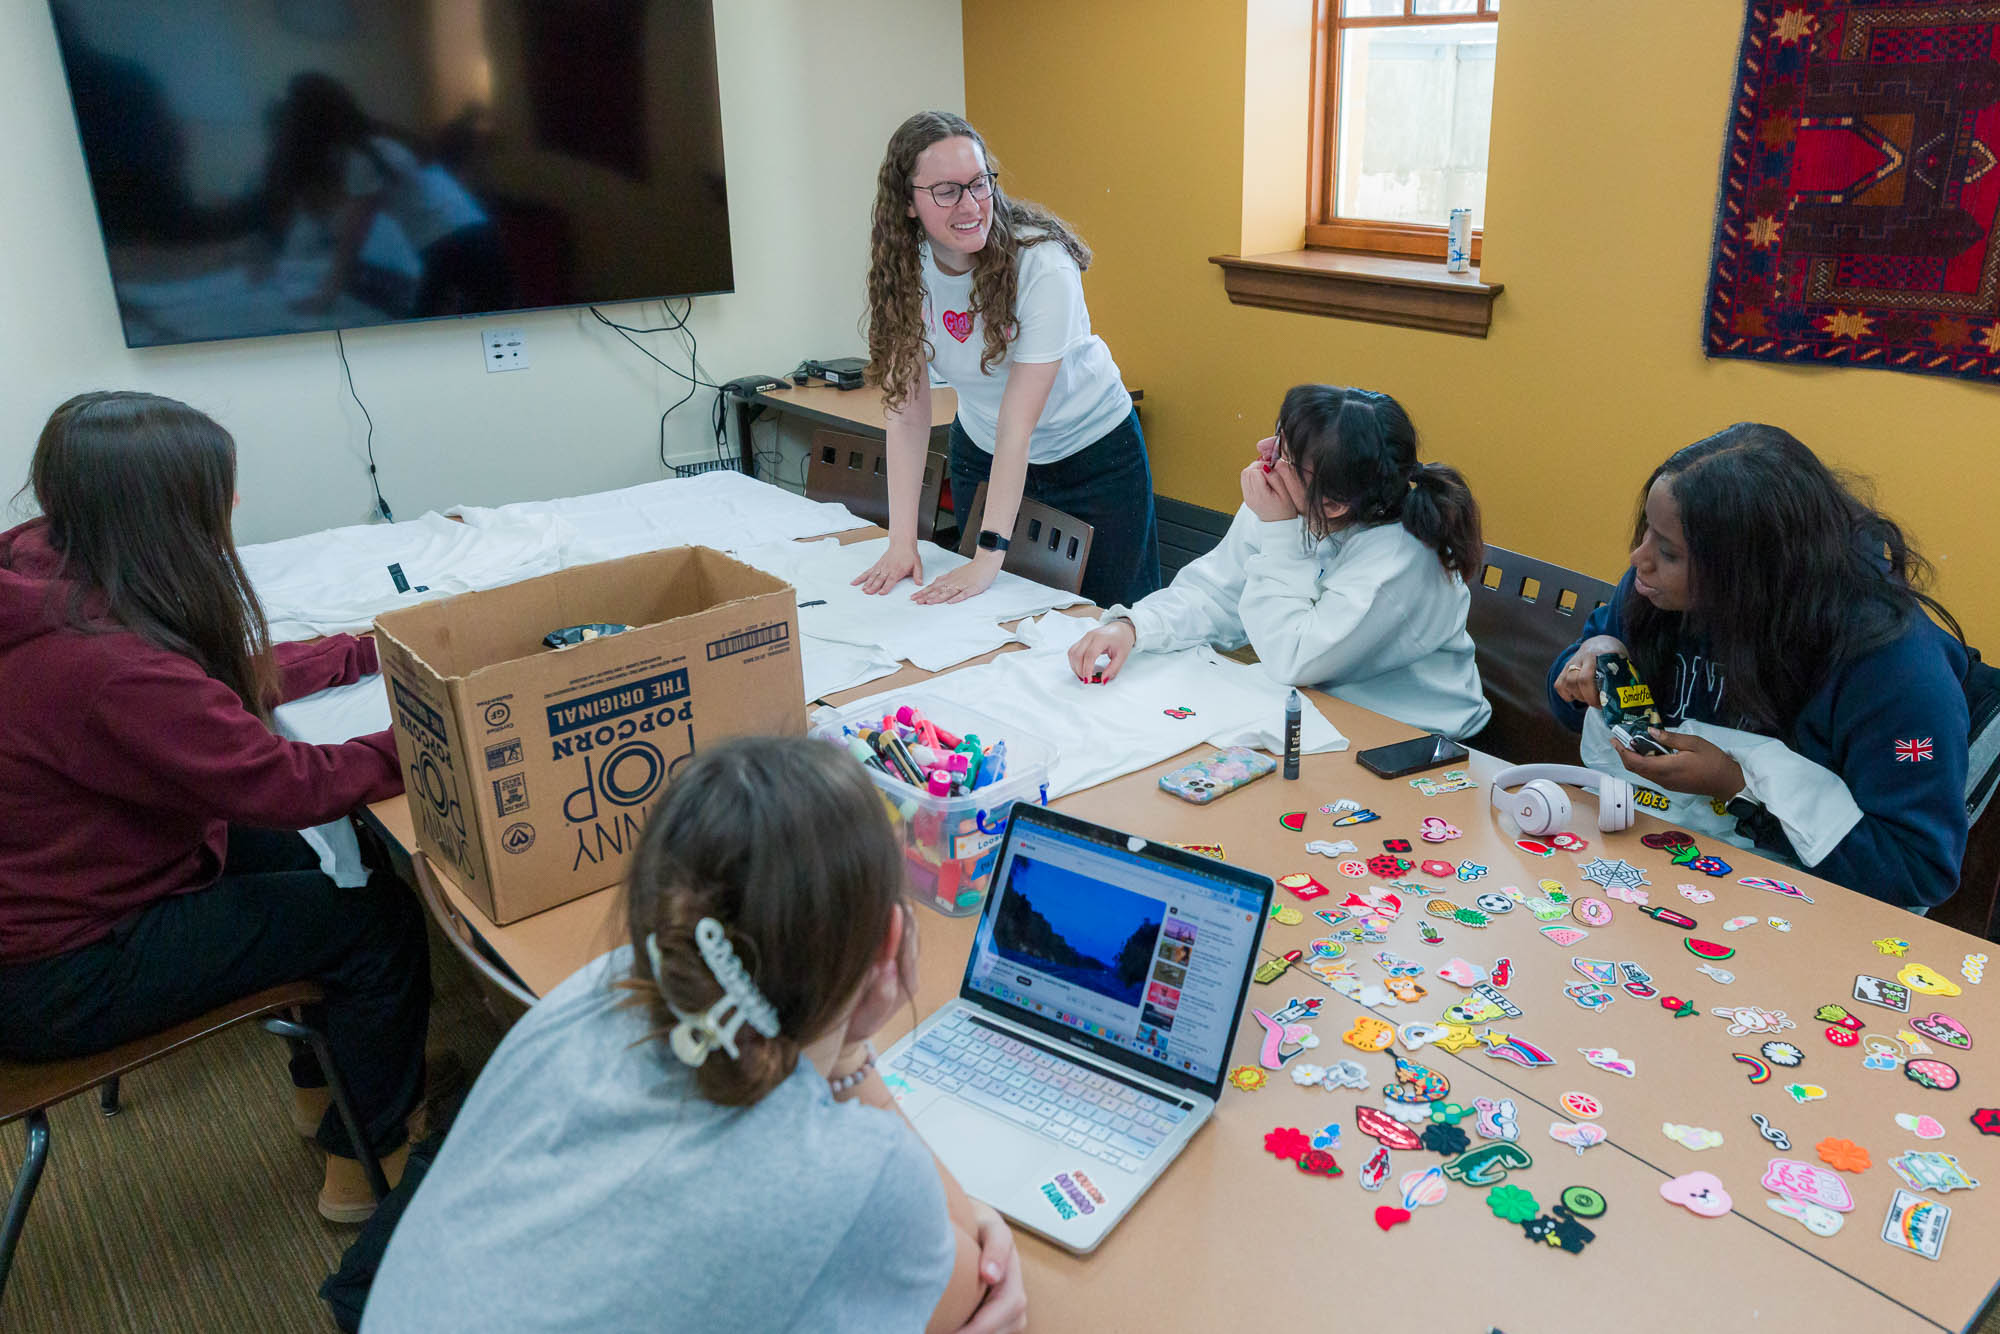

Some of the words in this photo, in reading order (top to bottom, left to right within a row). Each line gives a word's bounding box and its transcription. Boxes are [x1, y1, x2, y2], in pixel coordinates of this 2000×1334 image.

[651, 677, 687, 700] THE
[552, 690, 646, 726] ORIGINAL
[552, 701, 694, 761] POPCORN
